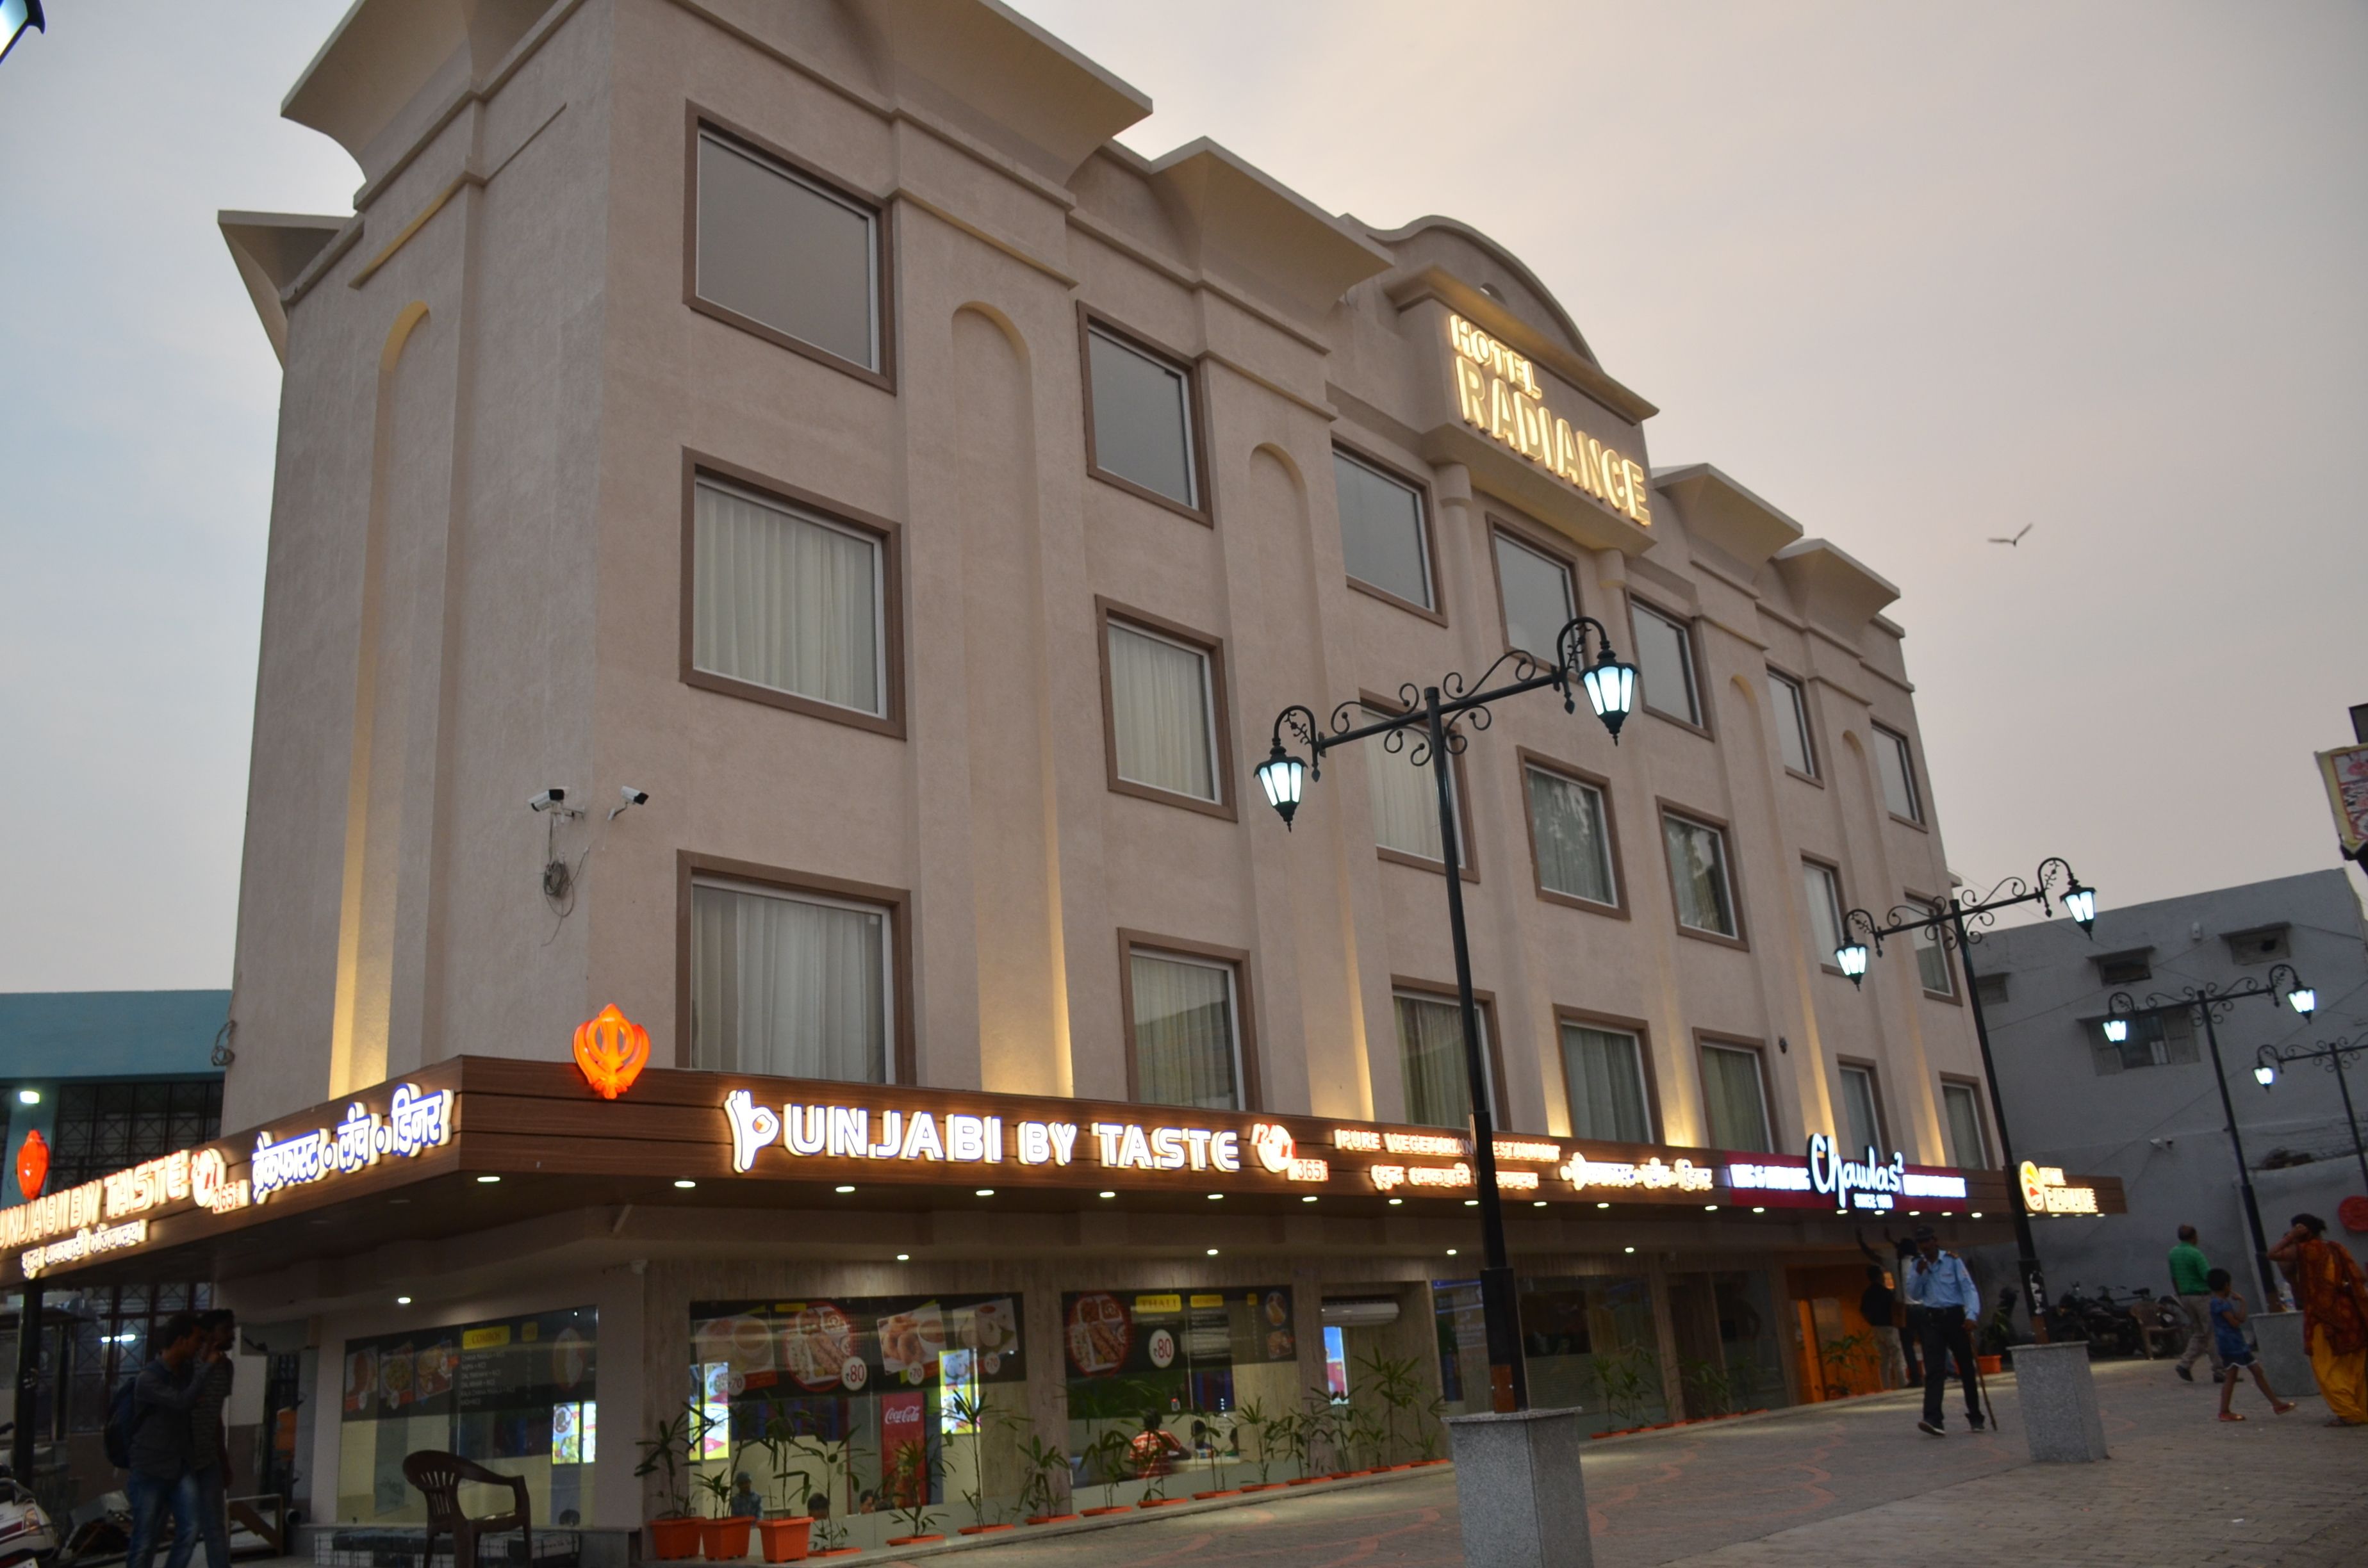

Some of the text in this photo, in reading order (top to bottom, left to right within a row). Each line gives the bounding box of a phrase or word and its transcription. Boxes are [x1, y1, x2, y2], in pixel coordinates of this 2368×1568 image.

[1450, 314, 1542, 400] HOTEL
[1456, 355, 1651, 527] RADIANCE
[391, 1083, 454, 1156] डिनर
[1017, 1120, 1076, 1166] BY
[1092, 1122, 1240, 1173] TASTE
[1335, 1129, 1381, 1151] PURE
[1493, 1141, 1561, 1162] ESTAURANT
[70, 1180, 102, 1229] BY
[104, 1150, 190, 1218] TASTE
[1297, 1160, 1321, 1180] 365
